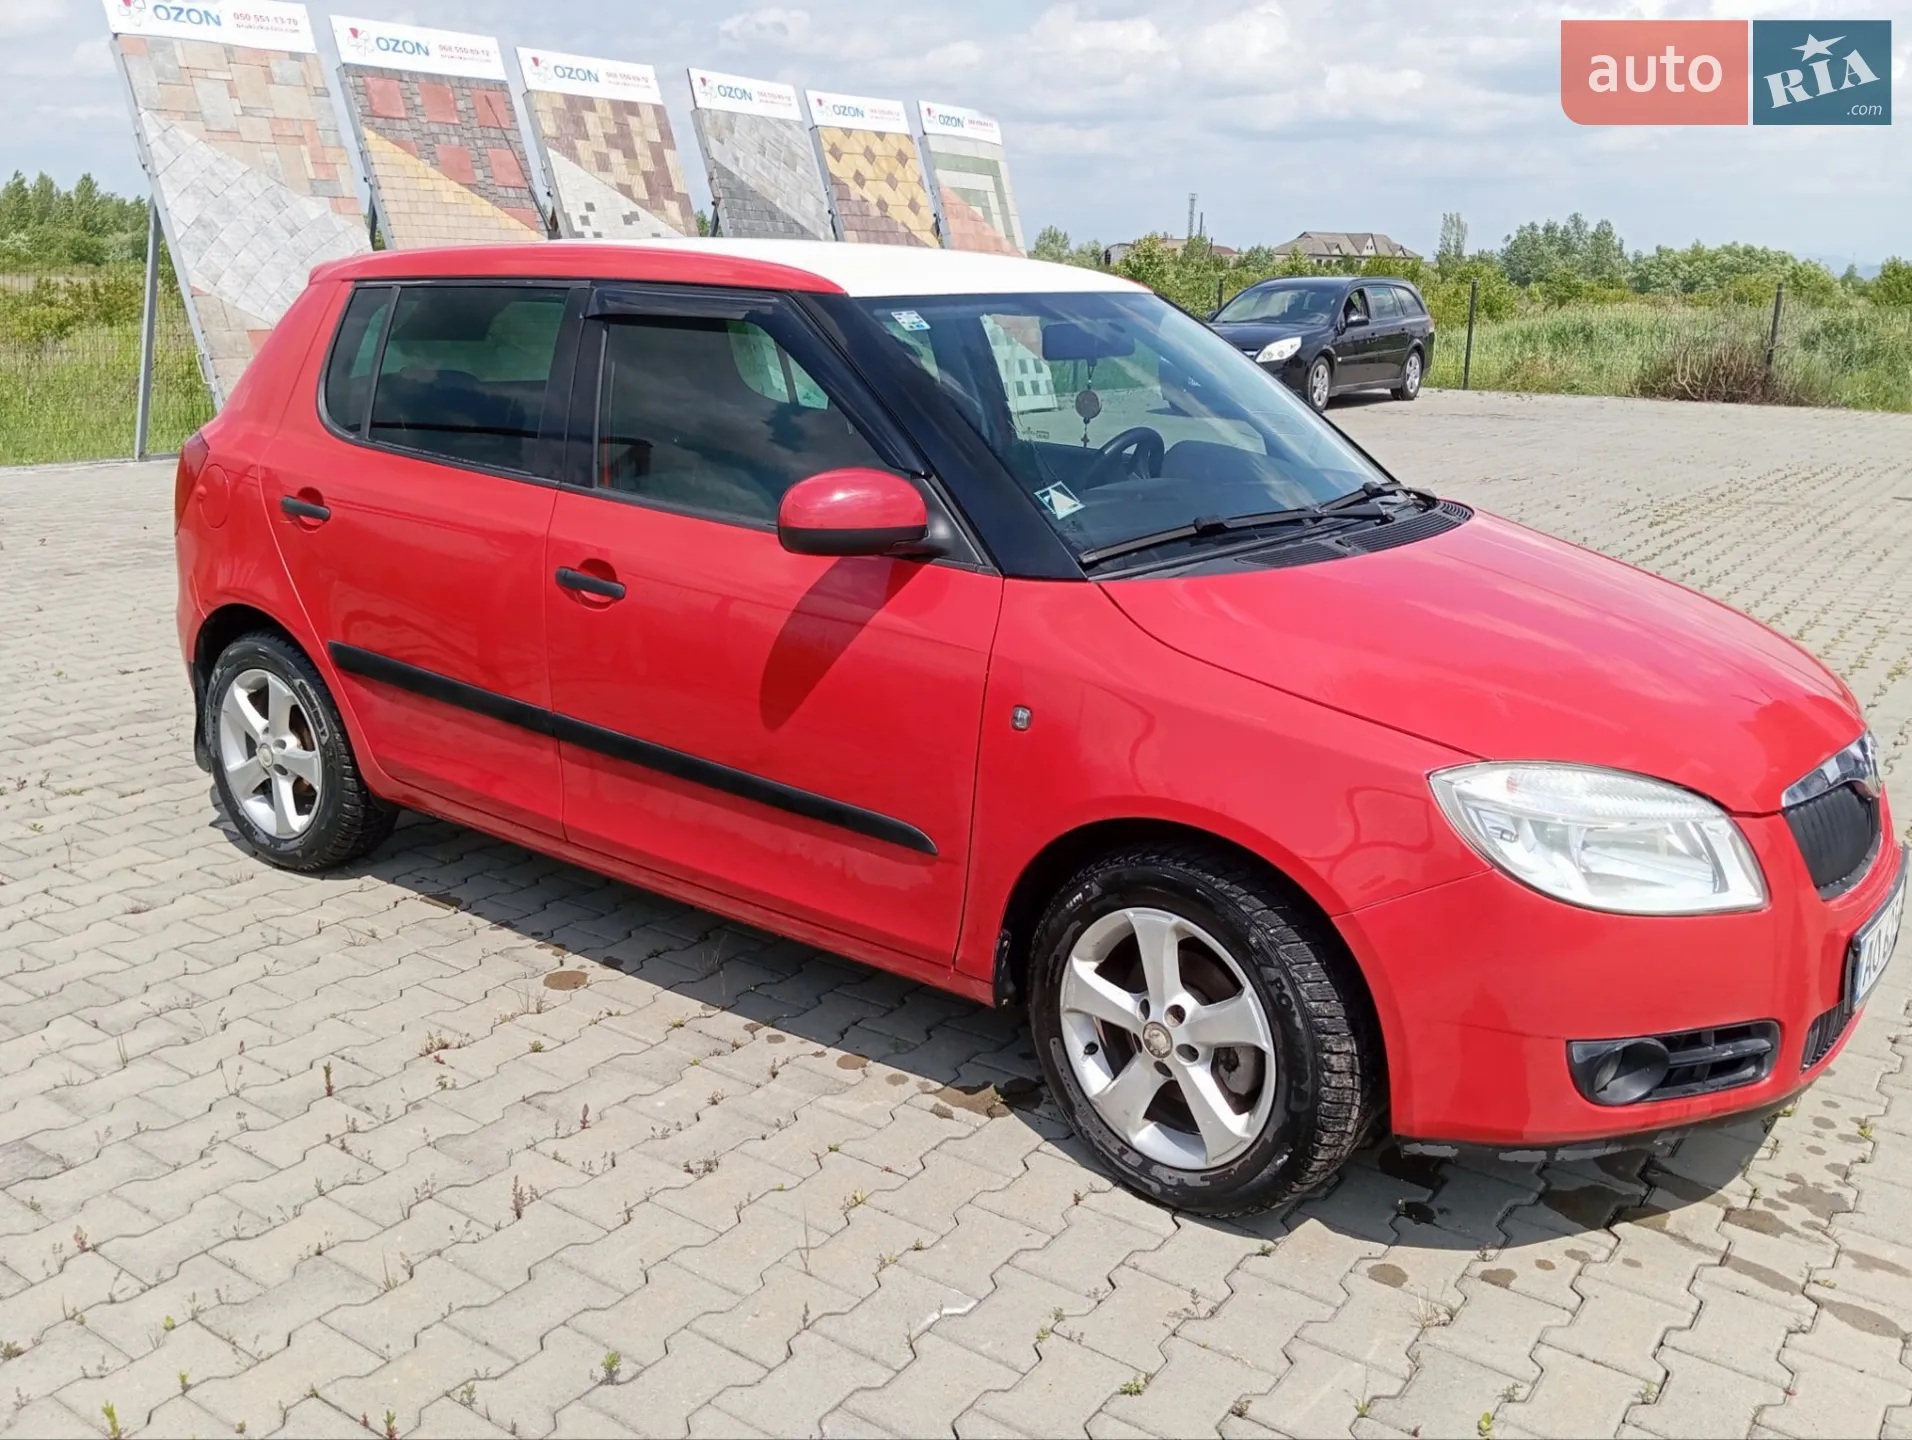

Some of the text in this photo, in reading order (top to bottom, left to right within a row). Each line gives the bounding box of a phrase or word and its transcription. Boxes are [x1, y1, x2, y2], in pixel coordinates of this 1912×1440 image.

[152, 4, 222, 27] OZON
[375, 37, 430, 57] OZON
[553, 65, 600, 83] OZON
[717, 84, 753, 101] OZON
[832, 104, 865, 118] OZON
[938, 114, 964, 128] OZON
